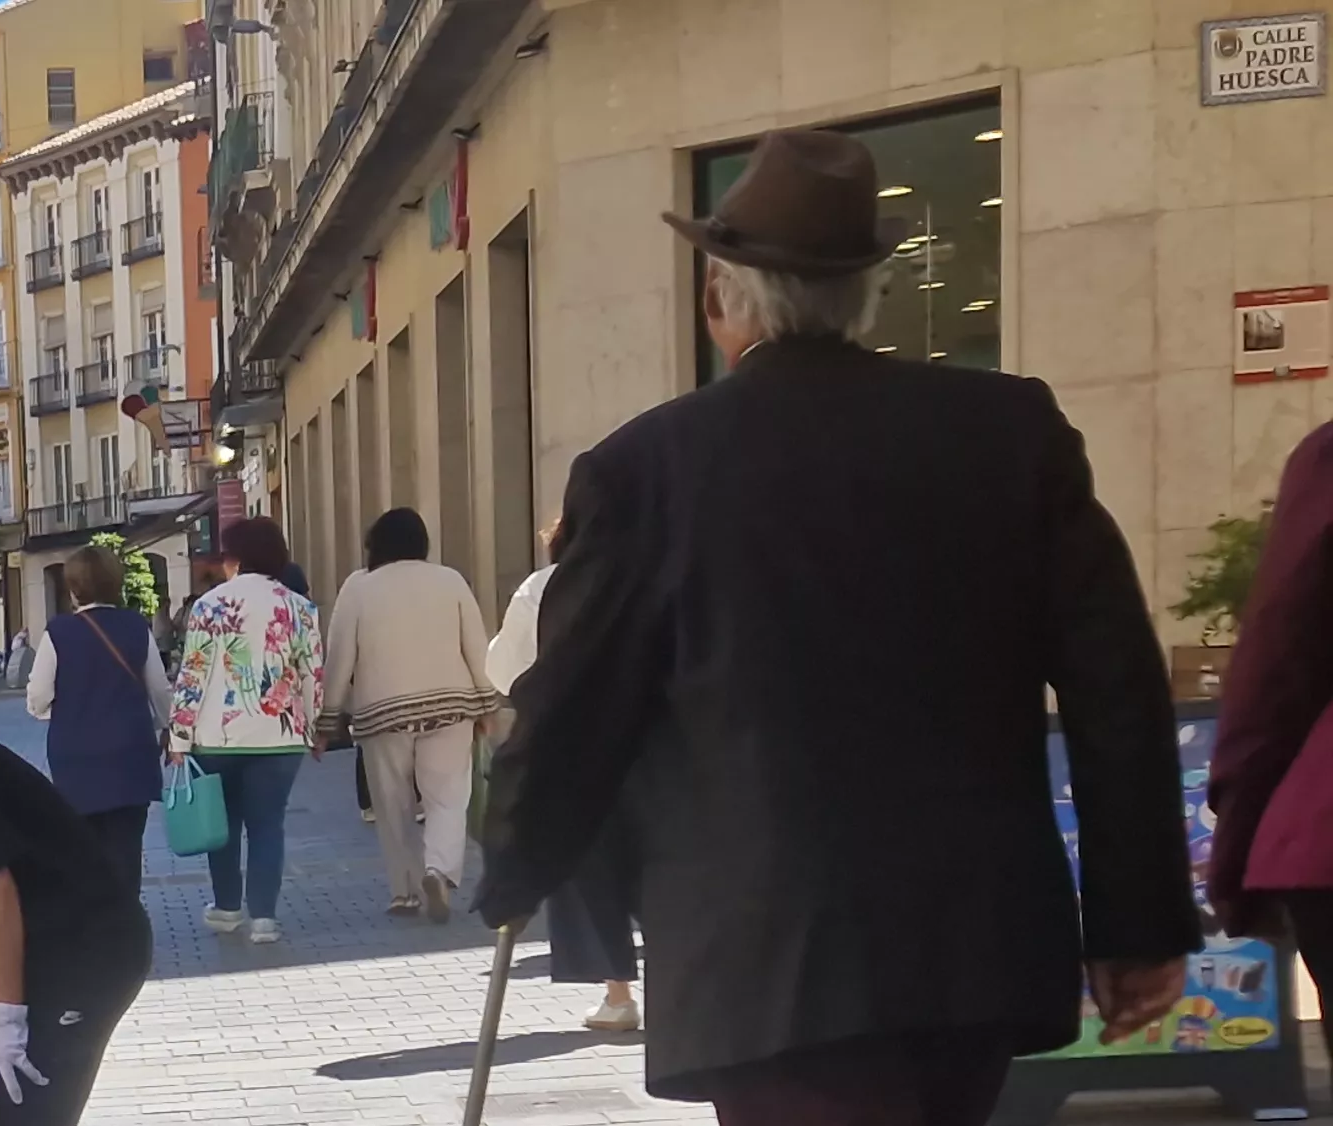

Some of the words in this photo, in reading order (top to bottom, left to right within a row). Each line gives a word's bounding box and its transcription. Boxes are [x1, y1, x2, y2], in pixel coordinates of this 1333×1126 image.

[1252, 26, 1307, 46] CALLE
[1245, 45, 1315, 69] PADRE
[1219, 66, 1310, 91] HUESCA
